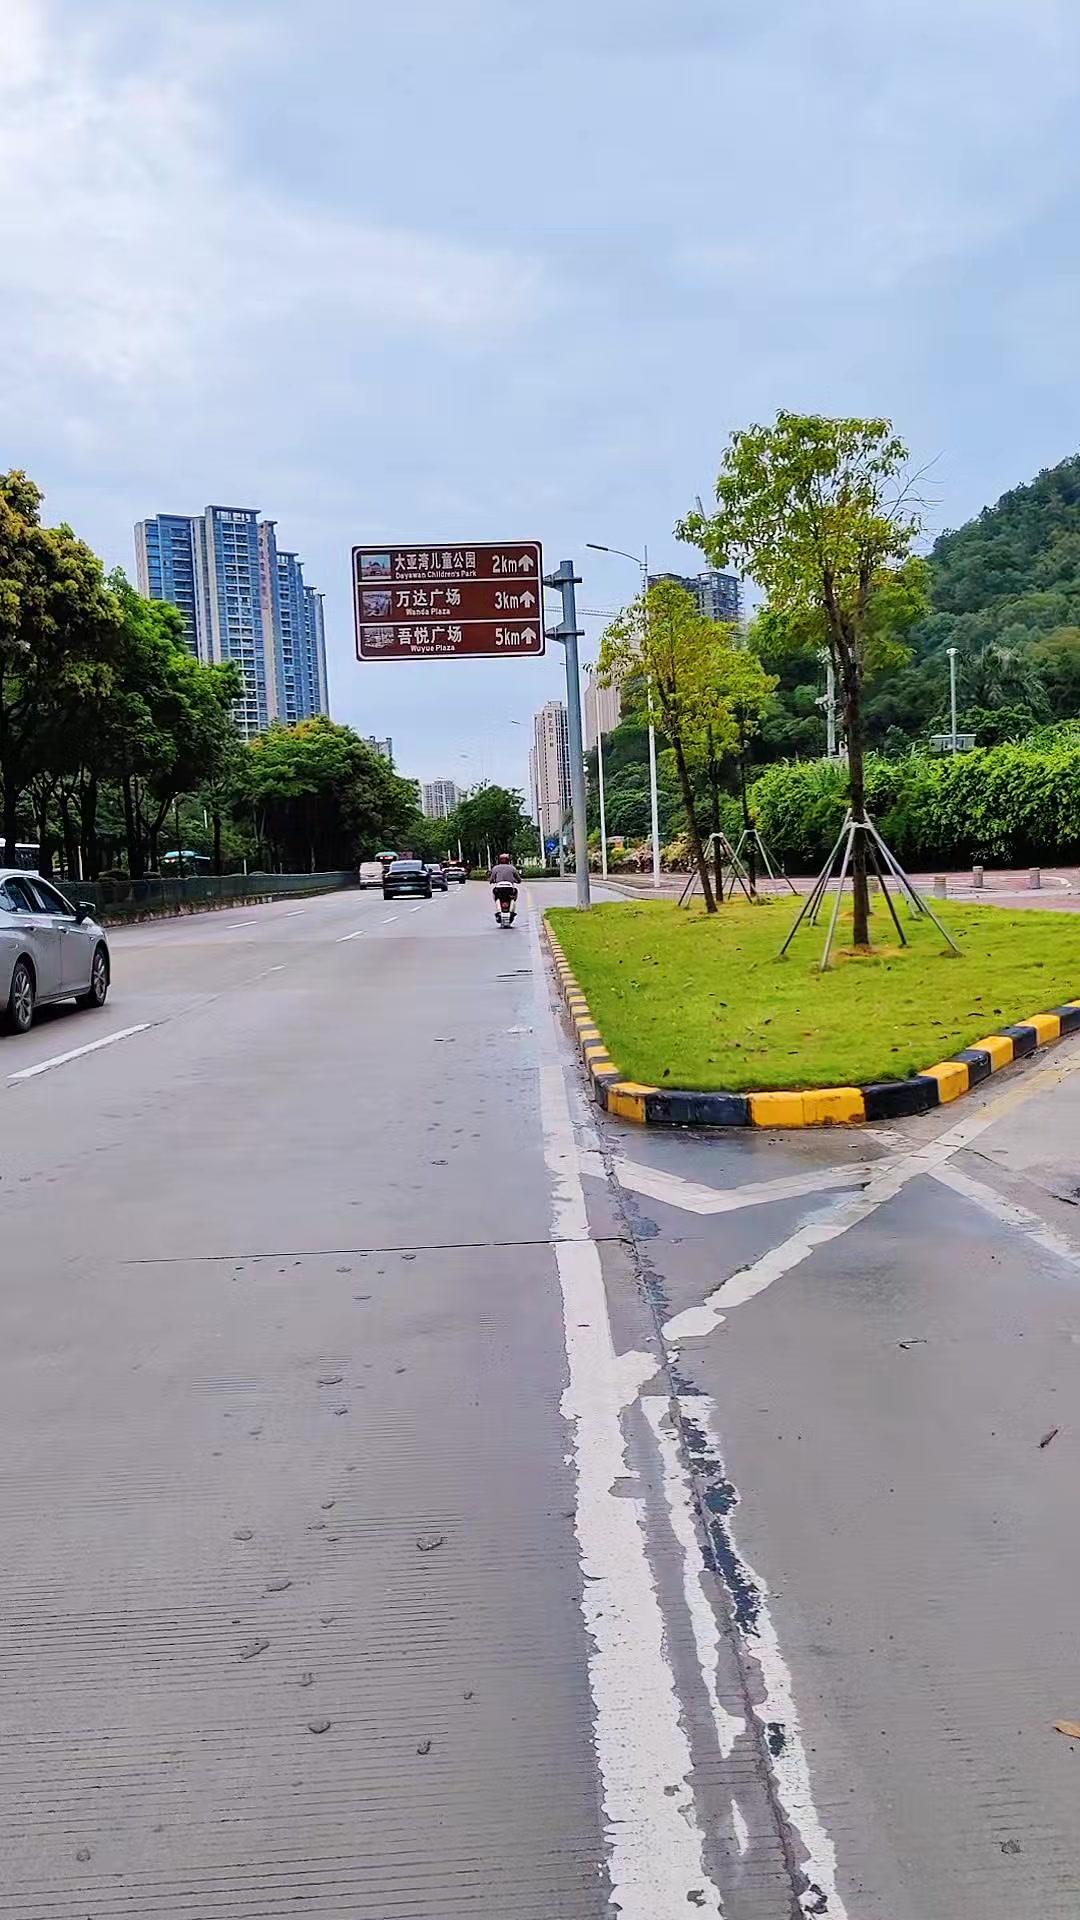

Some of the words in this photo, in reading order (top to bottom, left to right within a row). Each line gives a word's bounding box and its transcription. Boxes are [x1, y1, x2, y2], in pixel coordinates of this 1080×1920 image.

[394, 551, 476, 571] 大亚湾儿童公园
[492, 555, 518, 573] 2km
[395, 572, 427, 580] Dayawan
[427, 571, 460, 579] Children's
[396, 589, 461, 608] 万达广场
[494, 592, 519, 609] 3km
[406, 608, 430, 616] Wanda
[430, 607, 451, 615] Plaza
[397, 626, 462, 645] 吾悦广场
[495, 628, 520, 646] 5km
[410, 645, 435, 653] Wuyue
[435, 644, 455, 652] Plaza
